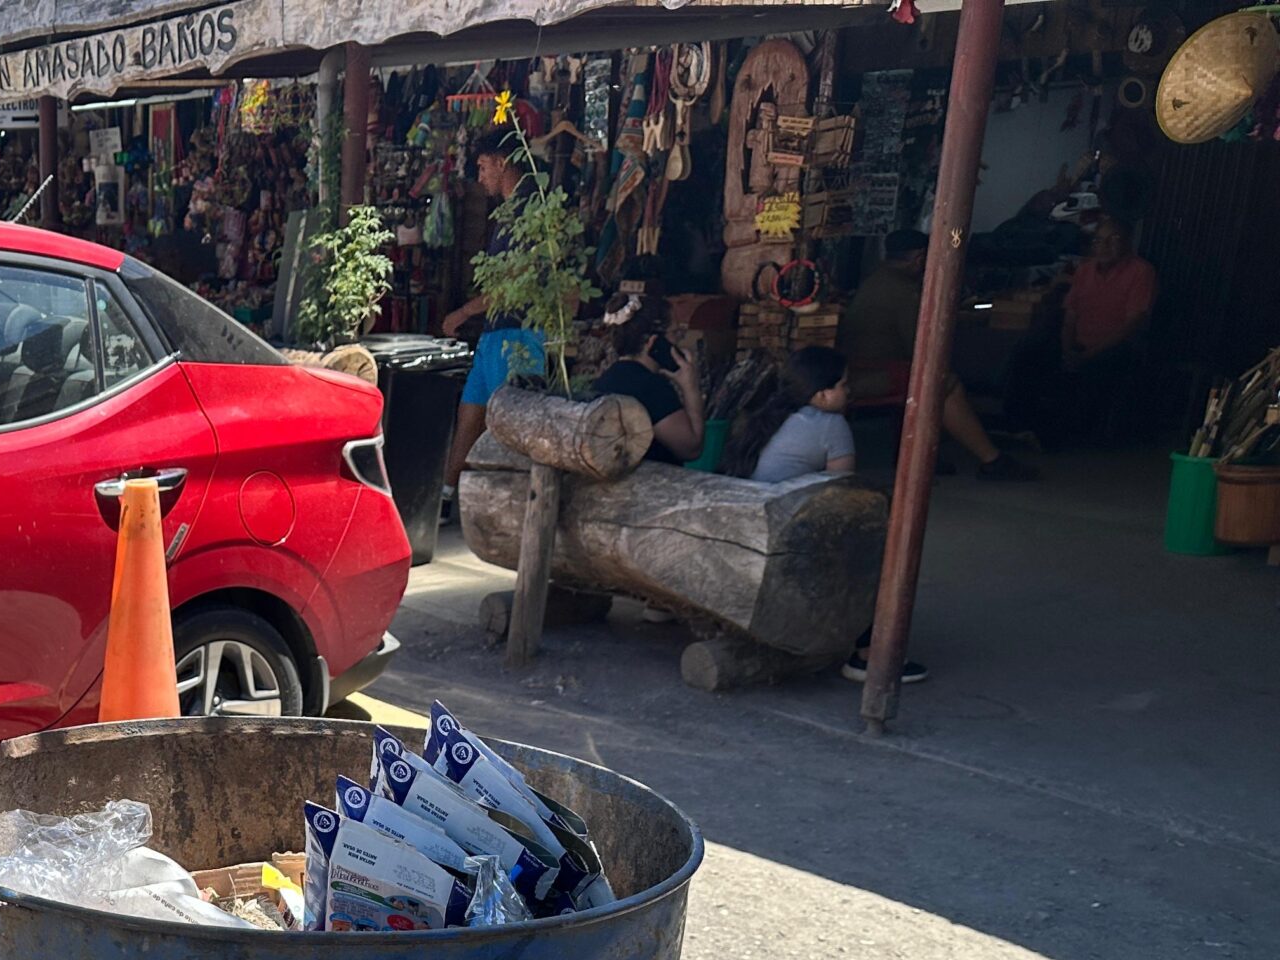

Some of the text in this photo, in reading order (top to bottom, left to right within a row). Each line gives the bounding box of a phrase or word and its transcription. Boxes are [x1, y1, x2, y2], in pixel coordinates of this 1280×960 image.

[22, 33, 126, 88] AMASADO
[141, 8, 238, 70] BAÑOS
[359, 855, 376, 867] AGITAR
[363, 851, 378, 861] ANTES
[152, 893, 161, 902] de
[160, 898, 176, 912] caña
[176, 908, 185, 917] de
